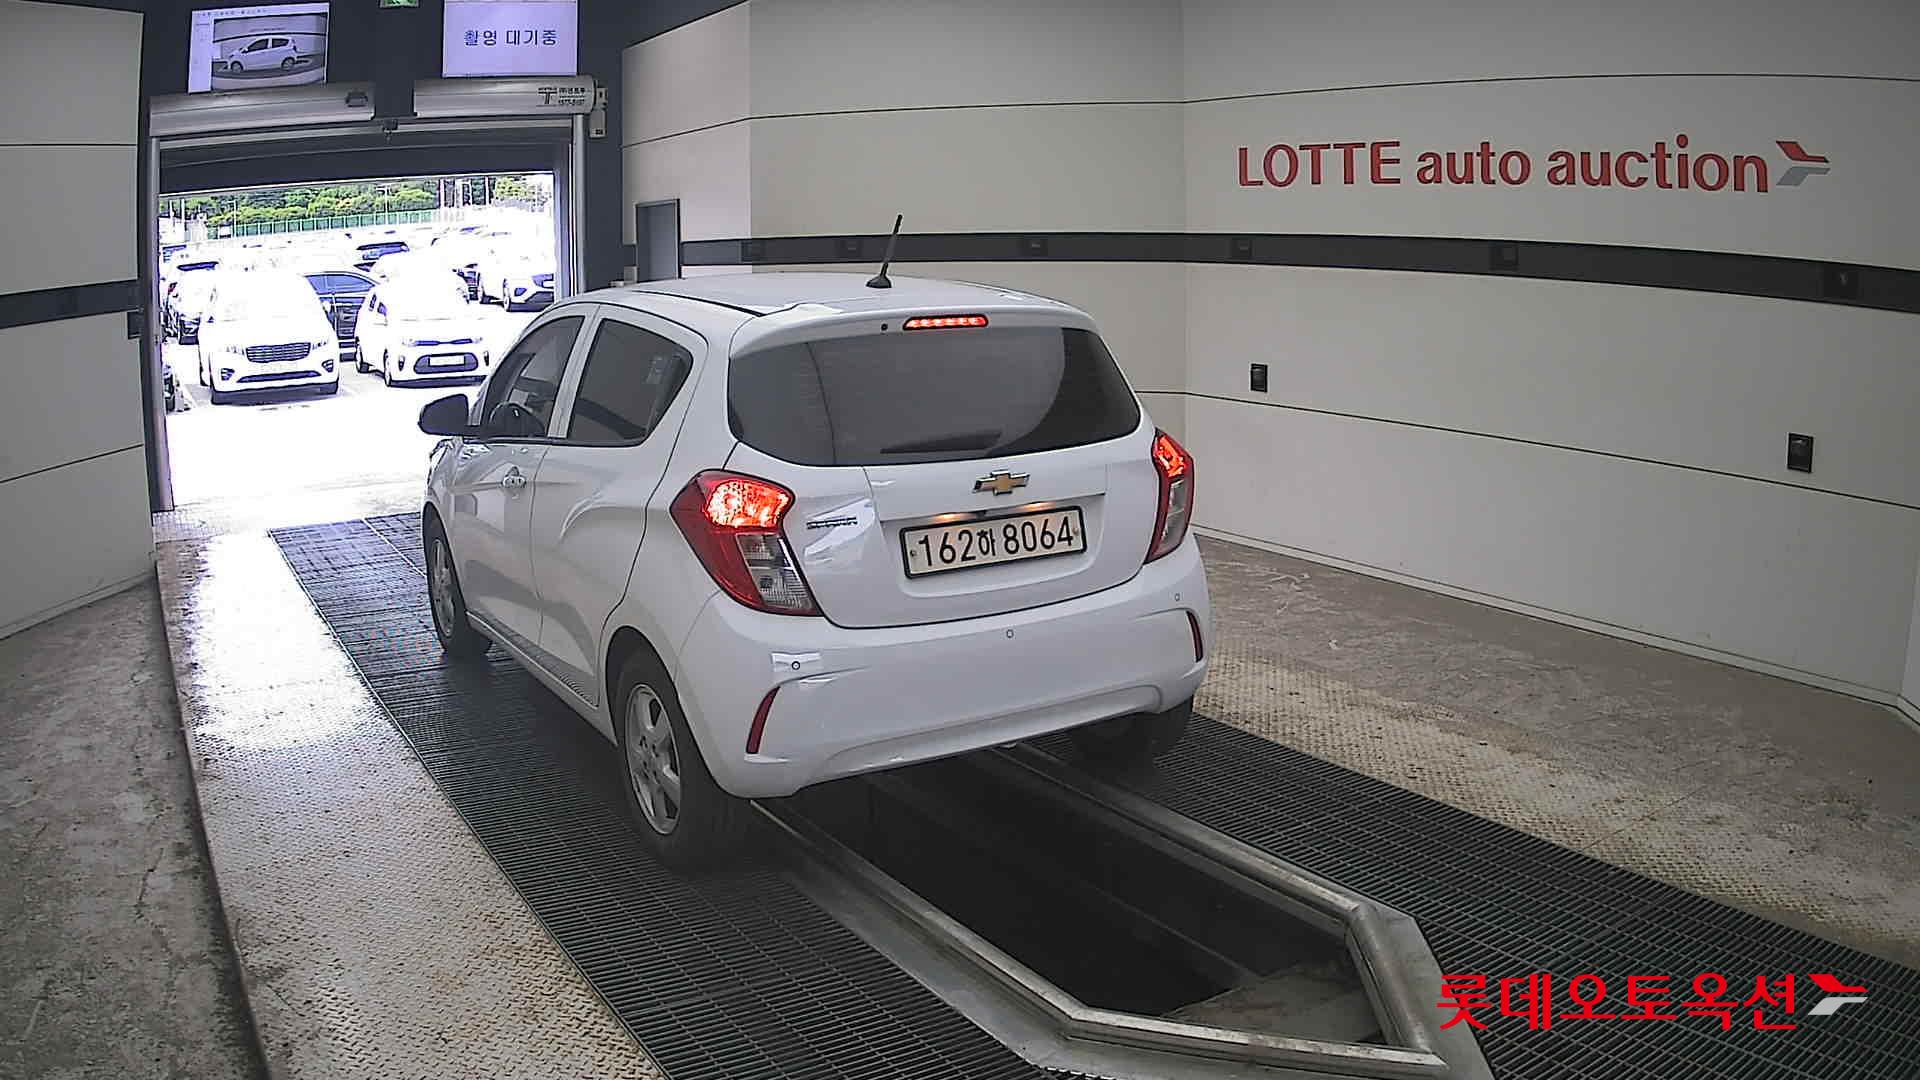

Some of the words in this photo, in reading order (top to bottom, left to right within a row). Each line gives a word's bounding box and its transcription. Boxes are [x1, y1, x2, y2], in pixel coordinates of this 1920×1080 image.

[463, 30, 497, 46] 촬영
[505, 29, 557, 46] 대기중
[1237, 141, 1401, 187] LOTTE
[1416, 141, 1532, 186] auto
[1546, 134, 1769, 193] auction
